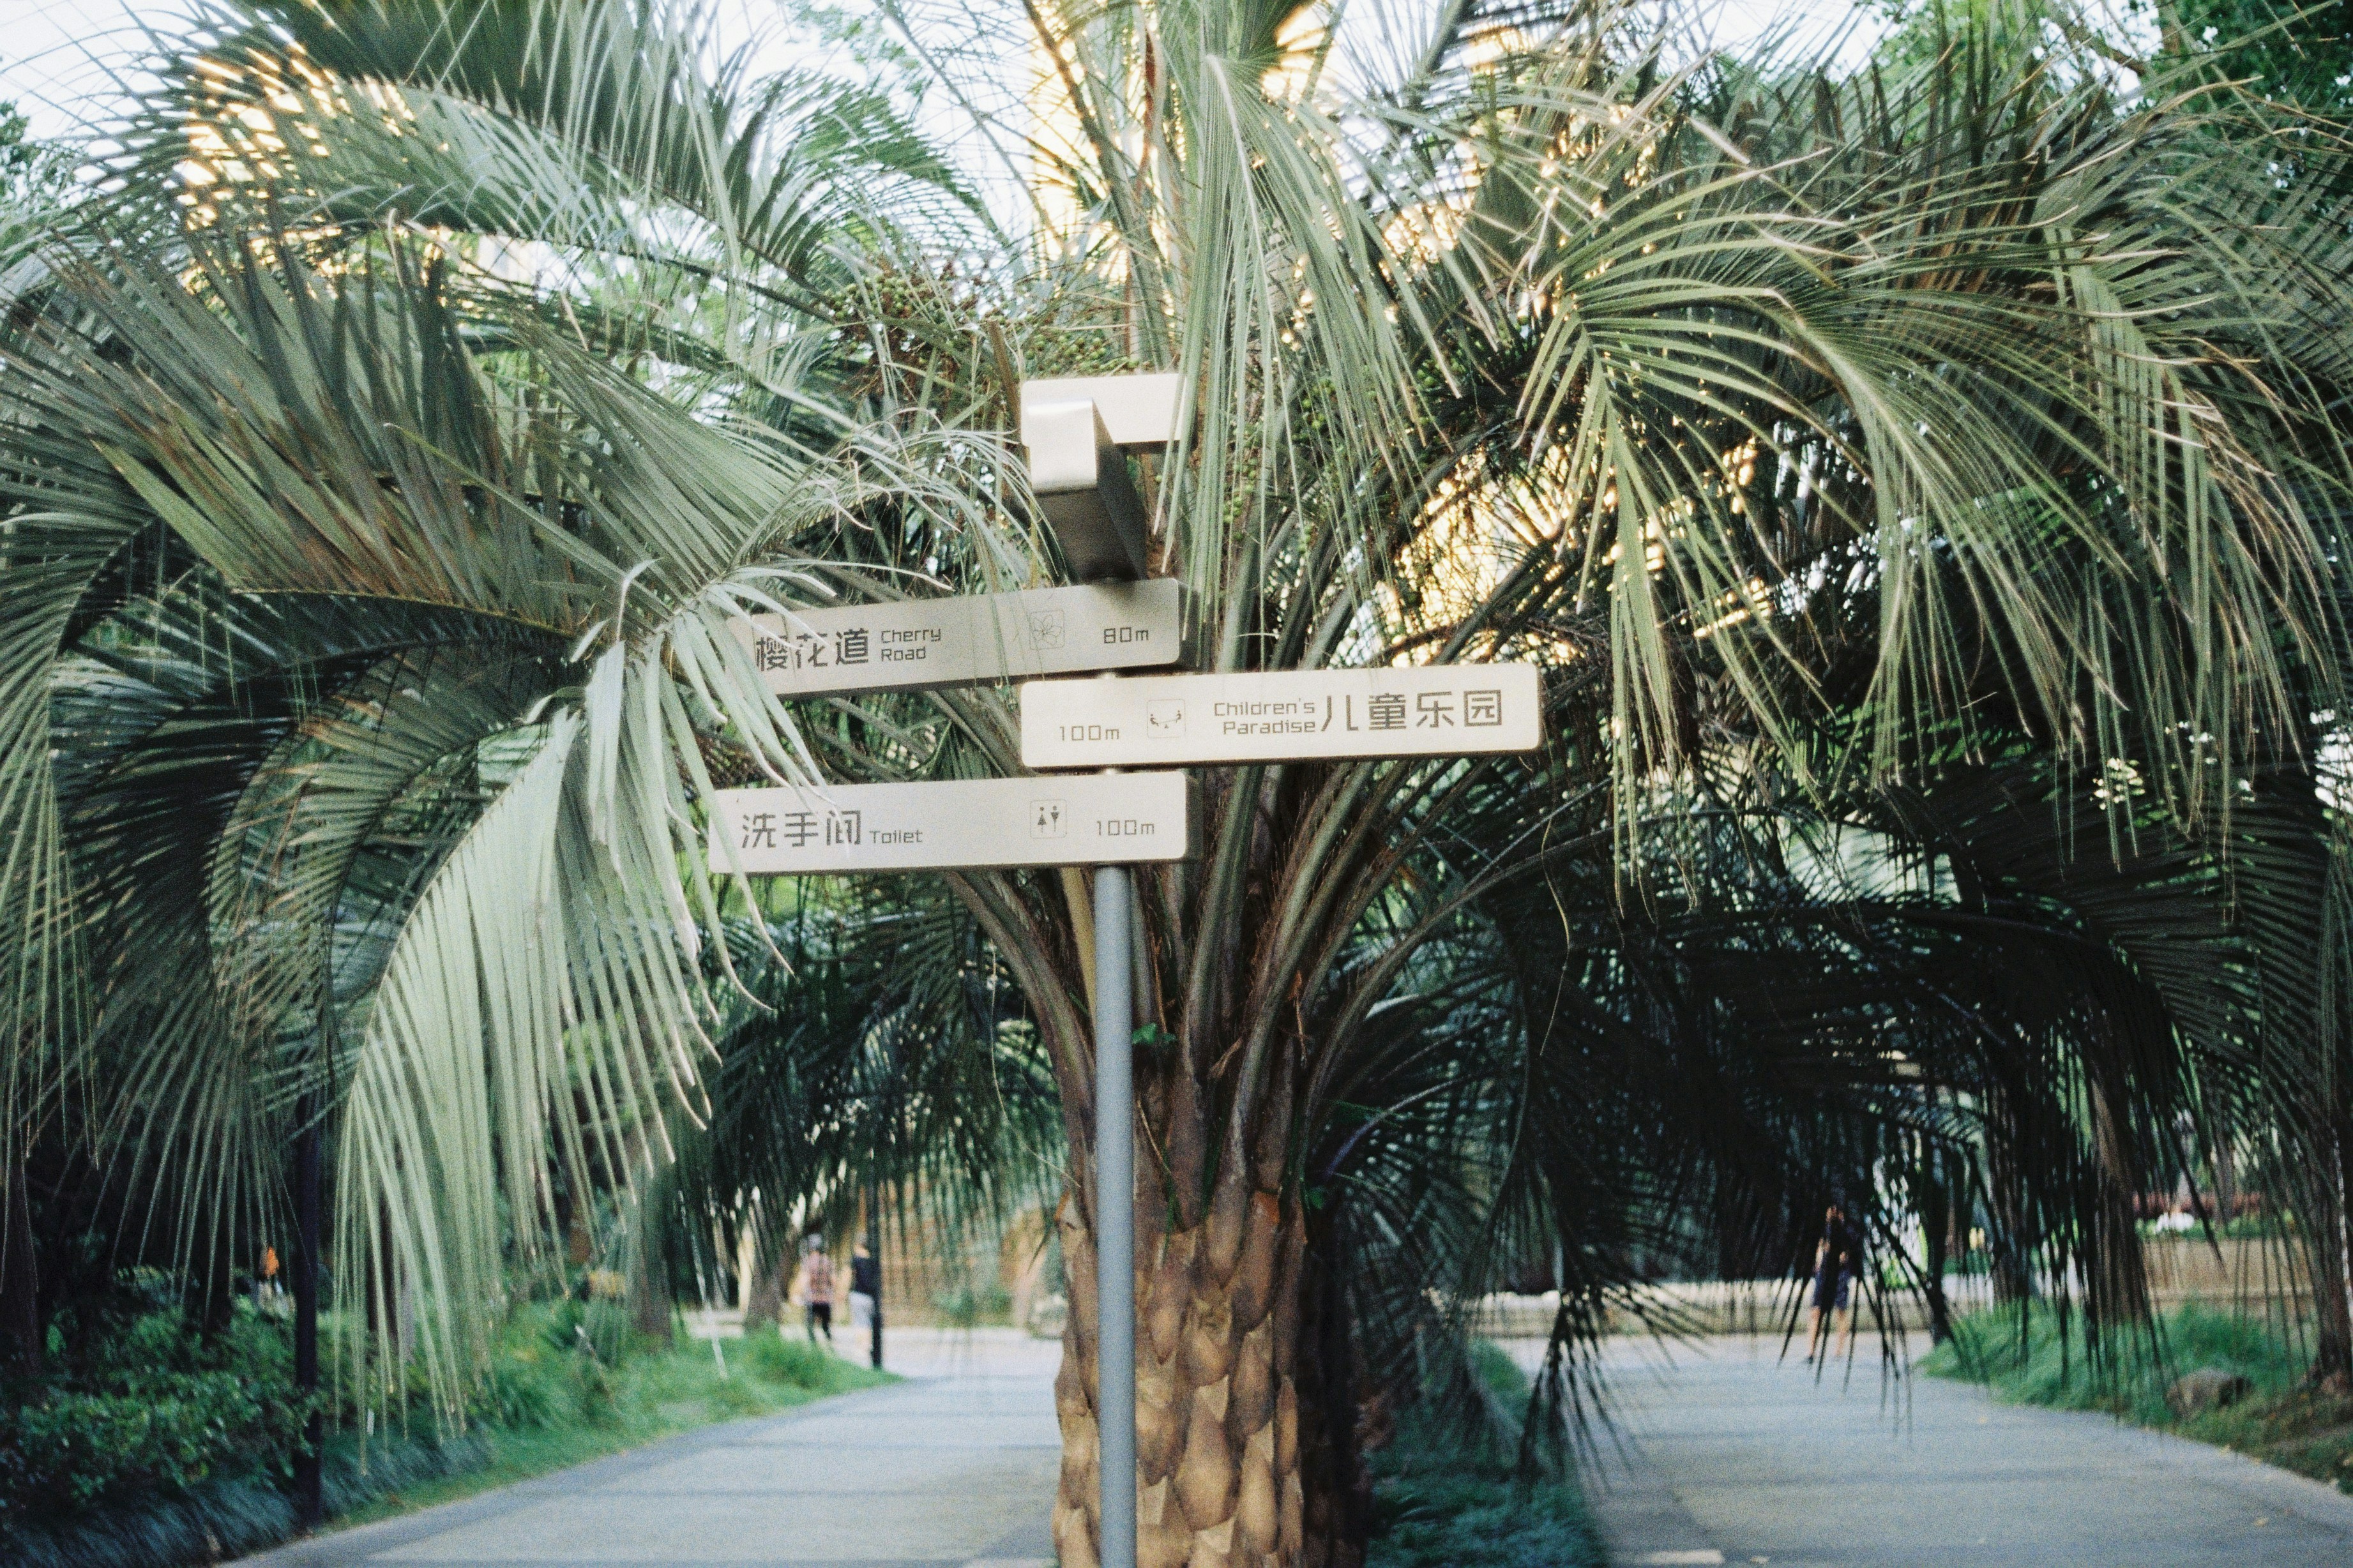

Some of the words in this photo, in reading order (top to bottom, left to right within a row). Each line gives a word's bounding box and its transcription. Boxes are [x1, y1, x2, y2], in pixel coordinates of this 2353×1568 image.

[881, 628, 941, 644] Cherry
[1103, 626, 1149, 644] 80m
[755, 628, 869, 672] 樱花道
[881, 645, 927, 661] Road
[1214, 697, 1315, 716] Children's
[1320, 690, 1502, 732] 儿童乐园
[1059, 725, 1119, 741] 100m
[1223, 719, 1315, 735] Paradise
[741, 810, 861, 848] 洗手间
[1096, 820, 1154, 836] 100m
[869, 829, 923, 845] Toilet
